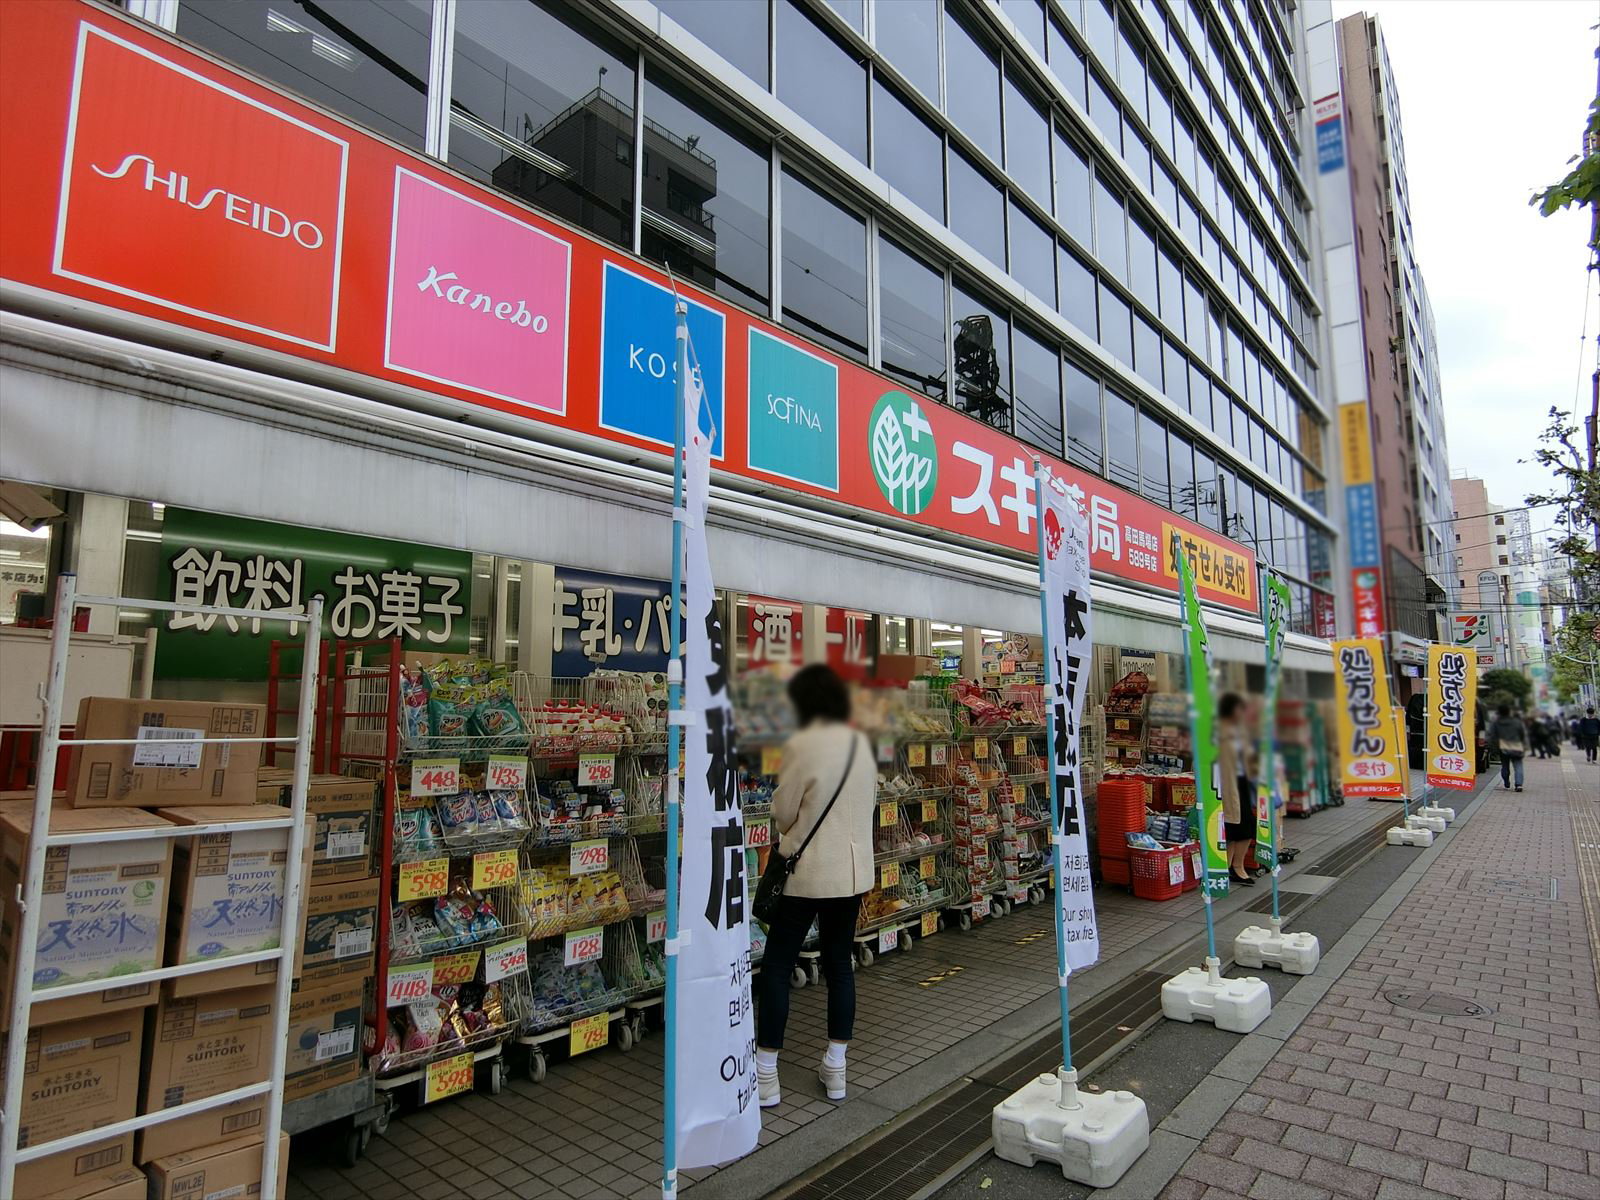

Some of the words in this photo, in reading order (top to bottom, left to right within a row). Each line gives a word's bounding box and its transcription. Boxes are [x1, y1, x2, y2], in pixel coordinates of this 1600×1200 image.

[91, 154, 324, 250] SHISEIDO
[417, 266, 548, 334] Kanebo
[767, 393, 823, 433] SOFINA
[951, 441, 1121, 562] スギ局
[1340, 645, 1385, 756] 処方せん
[420, 769, 456, 791] 448
[491, 767, 520, 785] 435
[1354, 762, 1387, 777] 受付
[747, 825, 769, 845] 168
[580, 846, 608, 866] 298
[227, 869, 277, 881] SUNTORY
[409, 871, 448, 893] 598
[482, 862, 516, 883] 598
[66, 885, 128, 900] SUNTORY
[38, 911, 147, 953] 天然水
[572, 937, 599, 959] 128
[390, 979, 428, 1001] 448
[186, 1043, 246, 1063] SUNTORY
[31, 1076, 102, 1101] SUNTORY
[436, 1067, 473, 1093] 598
[173, 1175, 204, 1193] MWL2E
